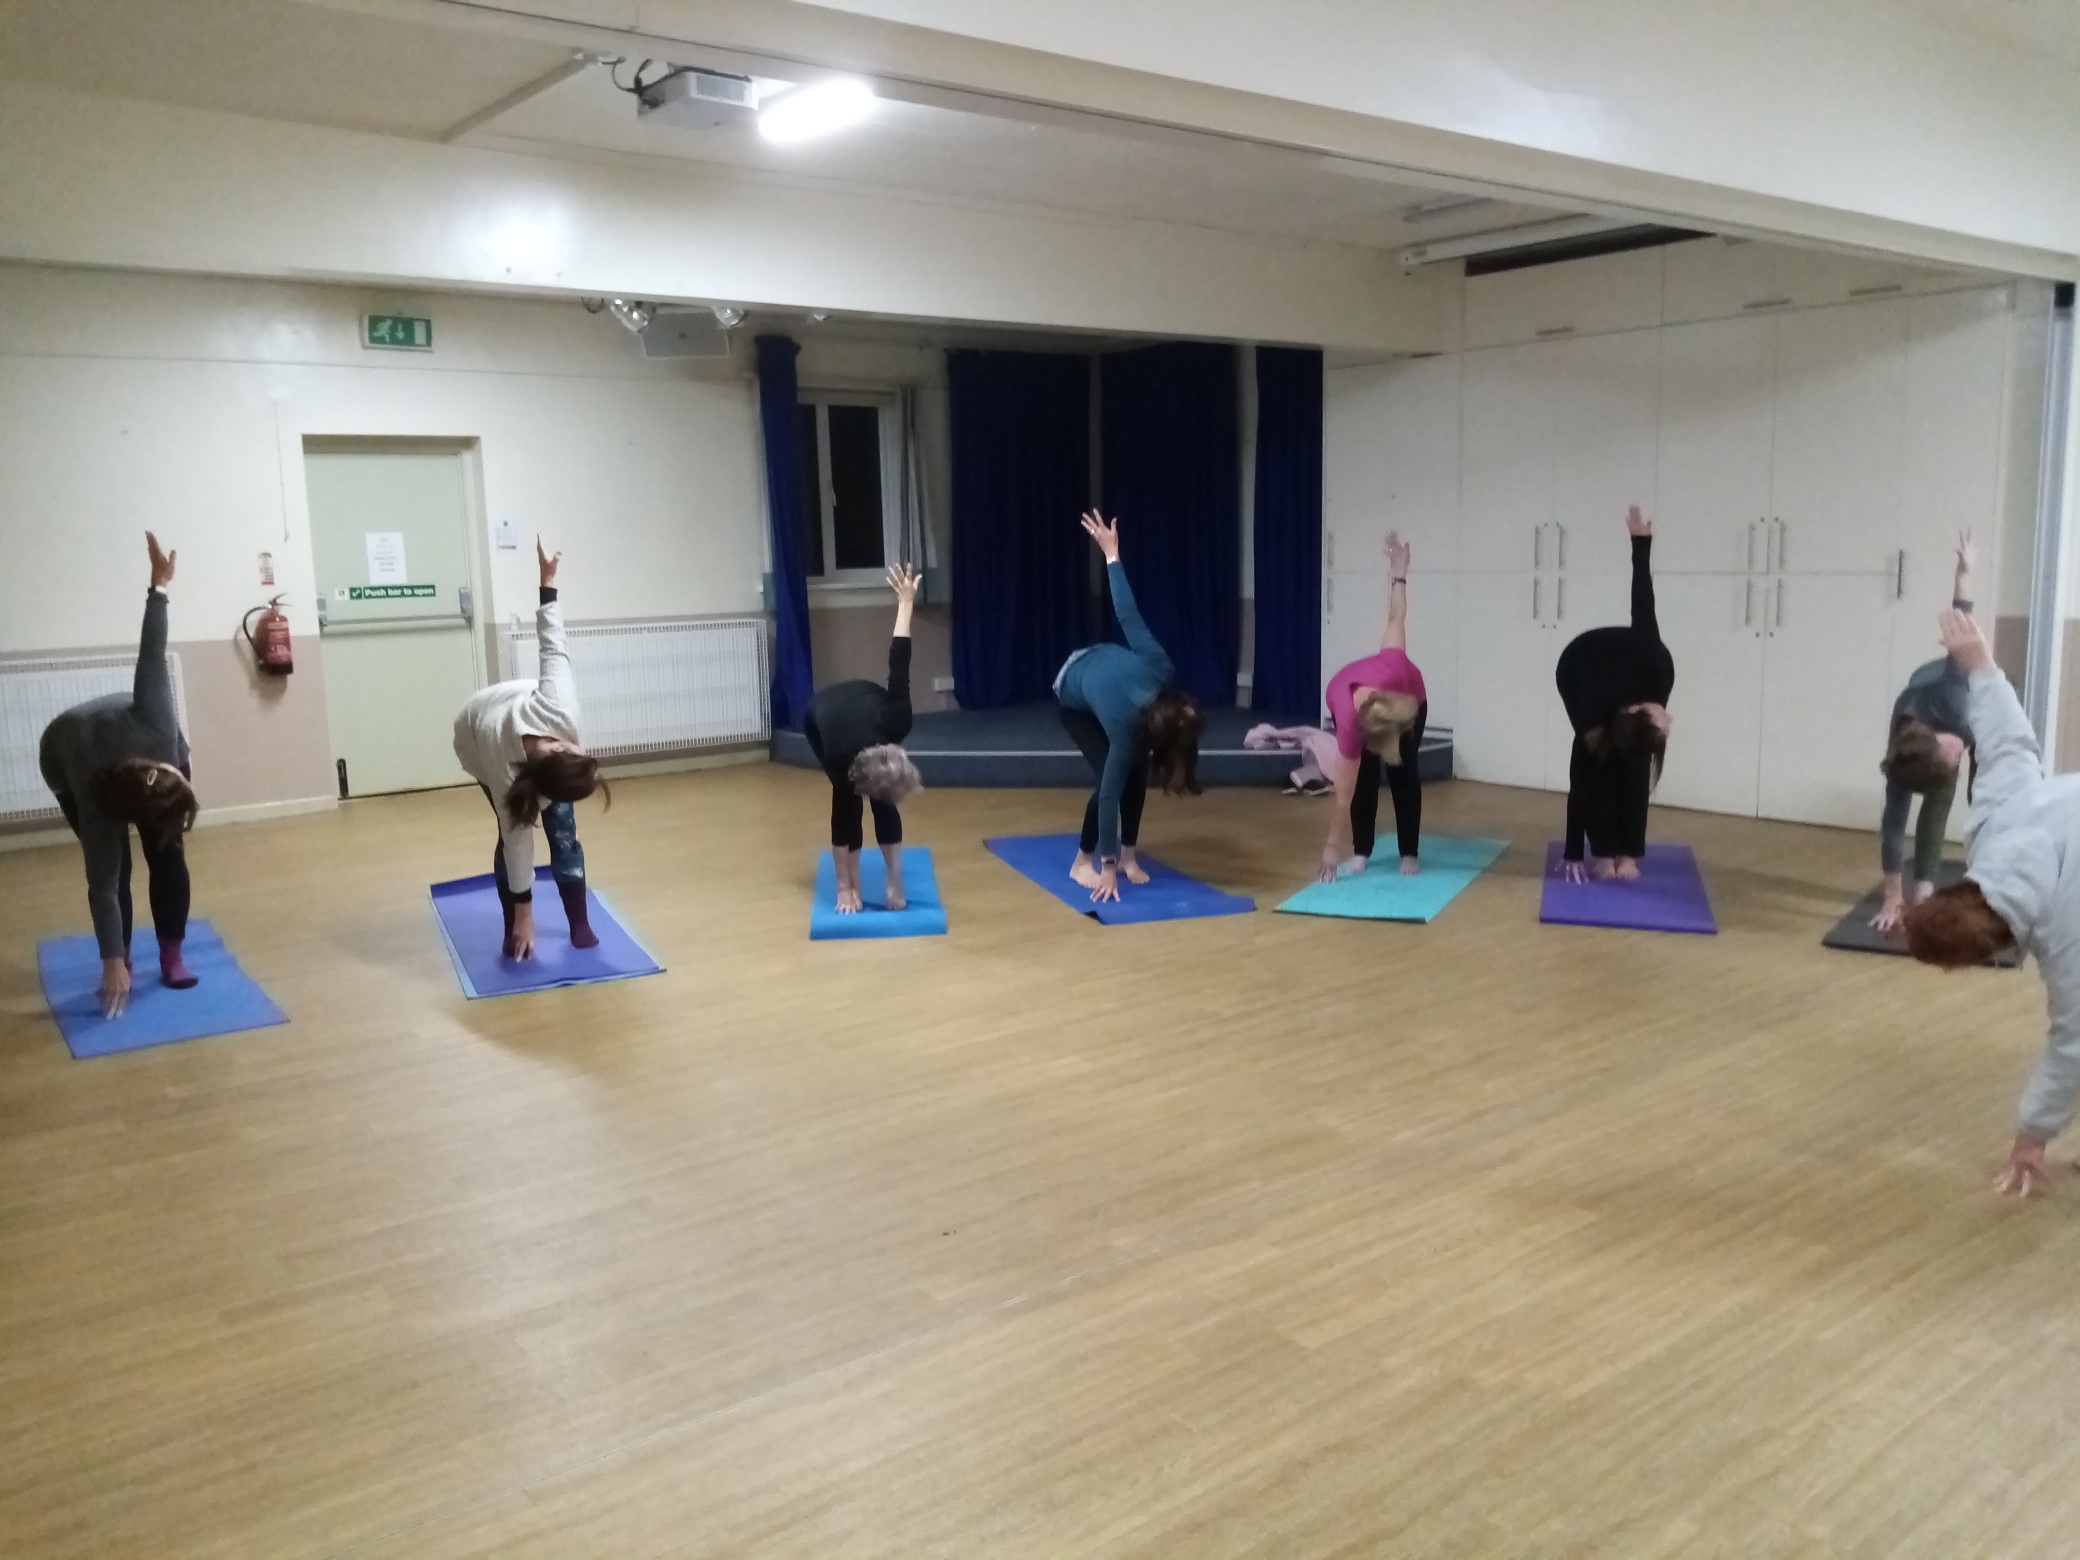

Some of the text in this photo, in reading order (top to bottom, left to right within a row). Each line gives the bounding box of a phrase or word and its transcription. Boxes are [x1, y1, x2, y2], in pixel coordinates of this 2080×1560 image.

[364, 588, 434, 596] Push bar to open
